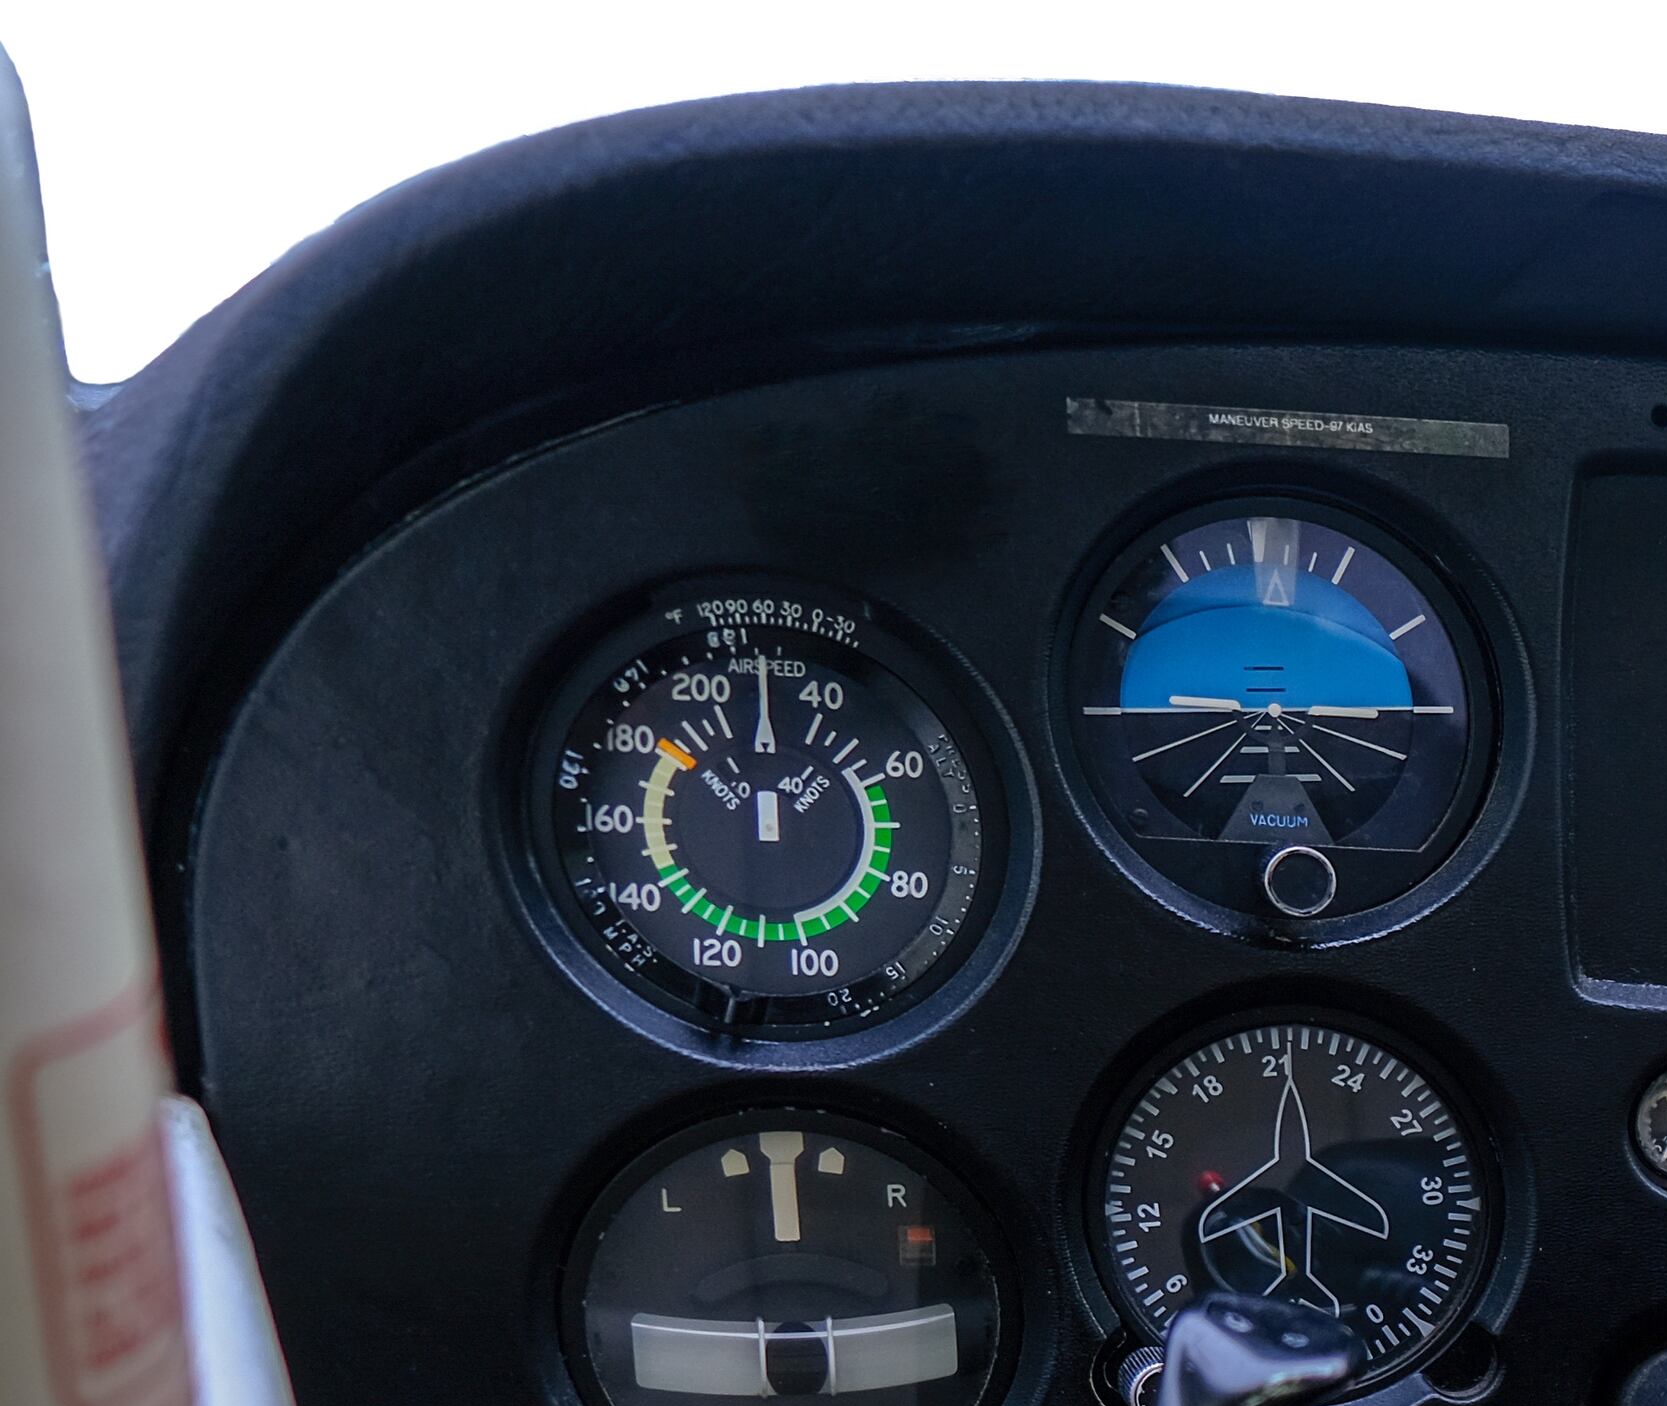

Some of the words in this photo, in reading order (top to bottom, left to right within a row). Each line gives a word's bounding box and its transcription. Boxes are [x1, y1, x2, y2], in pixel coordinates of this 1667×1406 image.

[1209, 413, 1279, 428] MANEUVER
[1346, 423, 1373, 434] KIAS
[671, 673, 731, 703] 200
[798, 680, 844, 710] 40
[606, 723, 655, 753] 180
[886, 749, 922, 781] 60
[702, 769, 740, 811] KNOTS
[793, 775, 830, 813] KNOTS
[1249, 812, 1309, 829] VACUUM
[609, 881, 661, 913] 140
[890, 870, 929, 900] 80
[693, 938, 742, 968] 120
[791, 949, 839, 977] 100
[1192, 1075, 1224, 1104] 18
[1331, 1064, 1365, 1093] 24
[1391, 1109, 1424, 1138] 27
[1145, 1130, 1175, 1160] 15
[661, 1188, 681, 1213] L
[887, 1184, 907, 1208] R
[1420, 1175, 1444, 1205] 30
[1137, 1202, 1161, 1234] 12
[1405, 1245, 1434, 1276] 33
